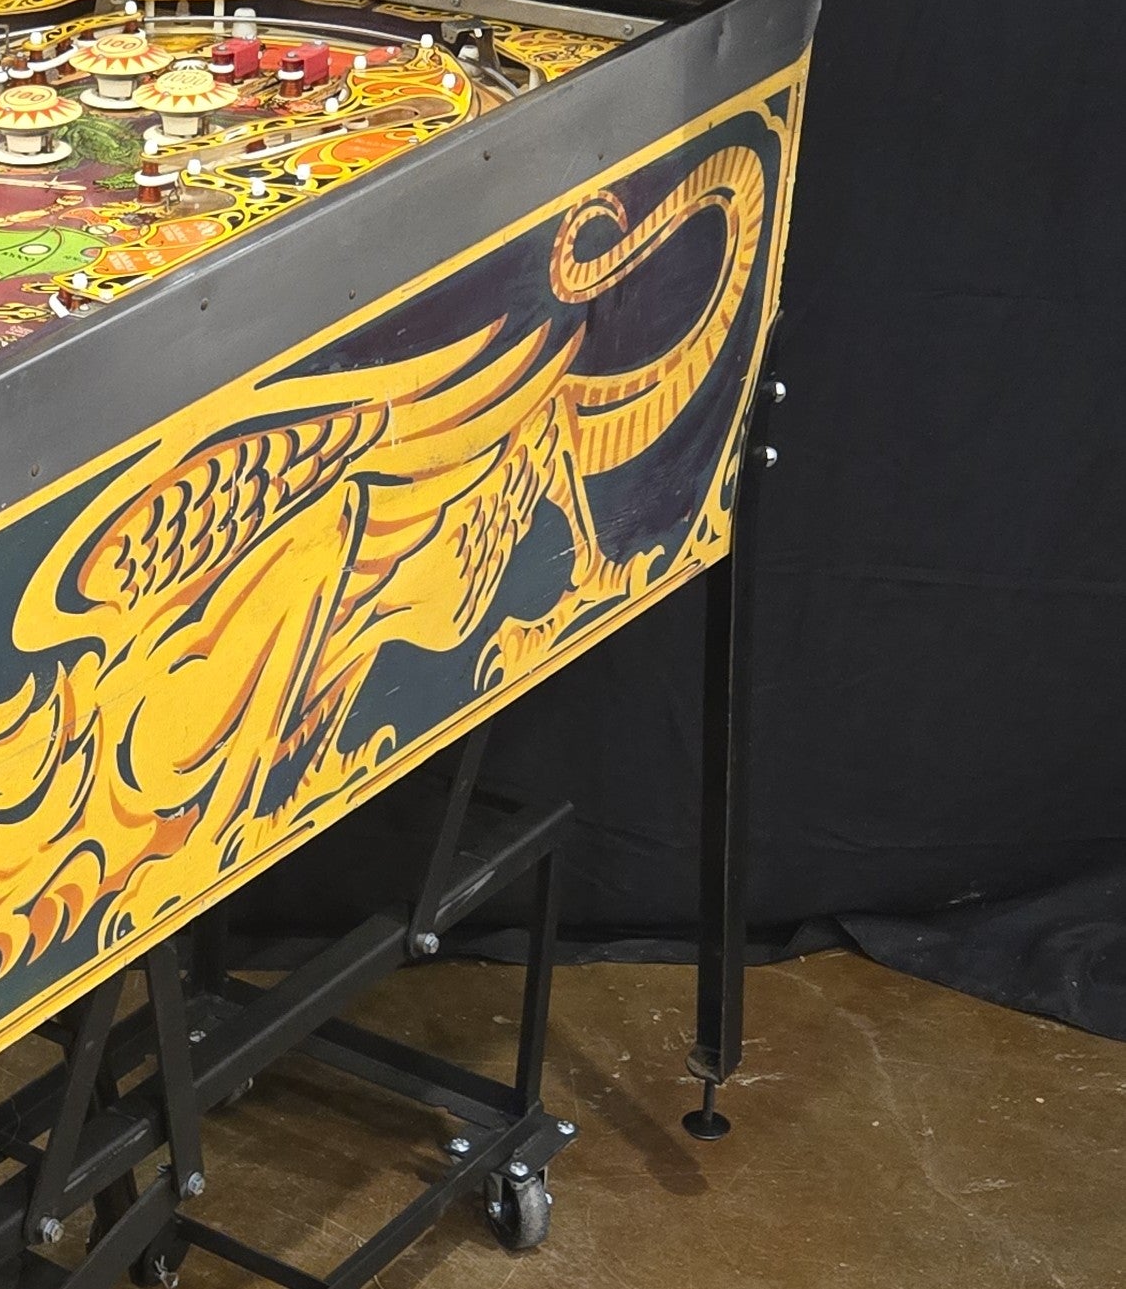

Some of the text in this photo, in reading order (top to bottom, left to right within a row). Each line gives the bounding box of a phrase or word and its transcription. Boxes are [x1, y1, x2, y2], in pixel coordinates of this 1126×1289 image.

[101, 37, 139, 50] 100
[162, 70, 208, 86] 1000
[7, 89, 46, 103] 100
